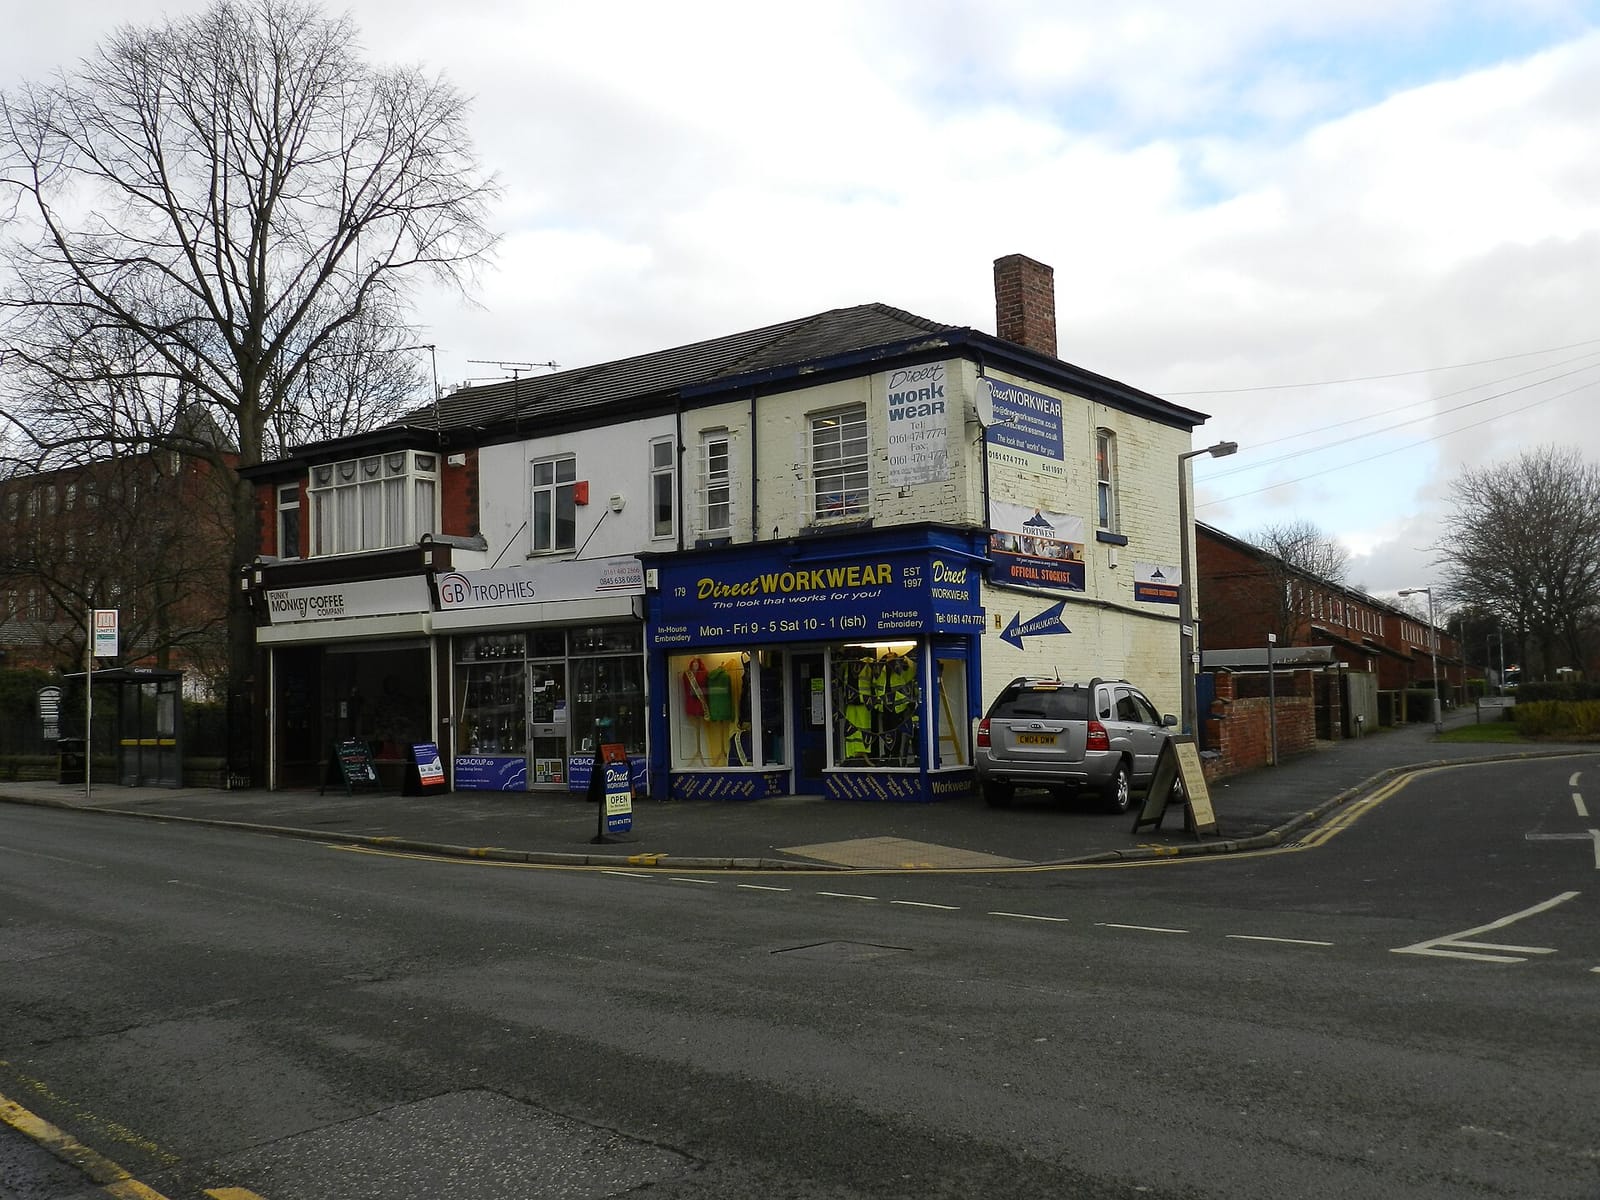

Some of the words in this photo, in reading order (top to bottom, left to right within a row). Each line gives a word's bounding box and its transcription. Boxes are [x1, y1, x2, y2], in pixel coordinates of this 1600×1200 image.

[889, 365, 944, 389] Direct
[889, 433, 907, 445] 0161
[910, 431, 924, 441] 474
[927, 427, 947, 440] 7774
[890, 455, 907, 466] 0161
[1022, 525, 1056, 539] PORTWEST
[903, 566, 920, 577] EST
[932, 560, 967, 585] Direct
[1010, 565, 1040, 580] OFFICIAL
[1041, 569, 1070, 583] STOCKIST
[903, 578, 922, 588] 1997
[271, 591, 289, 600] FUNKY
[442, 583, 465, 604] GB
[472, 581, 535, 601] TROPHIES
[674, 587, 686, 598] 179
[736, 599, 760, 608] look
[763, 597, 785, 606] that
[789, 594, 826, 603] works
[830, 592, 849, 601] for
[851, 589, 882, 600] you!
[931, 587, 969, 601] WORKWEAR
[272, 598, 306, 617] MONKEY
[309, 594, 344, 608] COFFEE
[317, 608, 345, 617] COMPANY
[882, 610, 918, 619] In-House
[935, 612, 946, 624] Tel:
[946, 613, 960, 624] 0161
[960, 614, 972, 625] 474
[658, 625, 687, 633] In-House
[700, 625, 723, 637] Mon
[733, 622, 748, 634] Fri
[751, 622, 759, 633] 9
[769, 621, 777, 632] 5
[780, 619, 800, 631] Sat
[803, 618, 817, 630] 10
[829, 618, 835, 628] 1
[840, 615, 867, 630] (ish)
[877, 620, 923, 630] Embroidery
[655, 634, 691, 643] Embroidery
[606, 769, 629, 783] Direct
[931, 780, 972, 794] Workwear
[610, 795, 628, 804] OPEN
